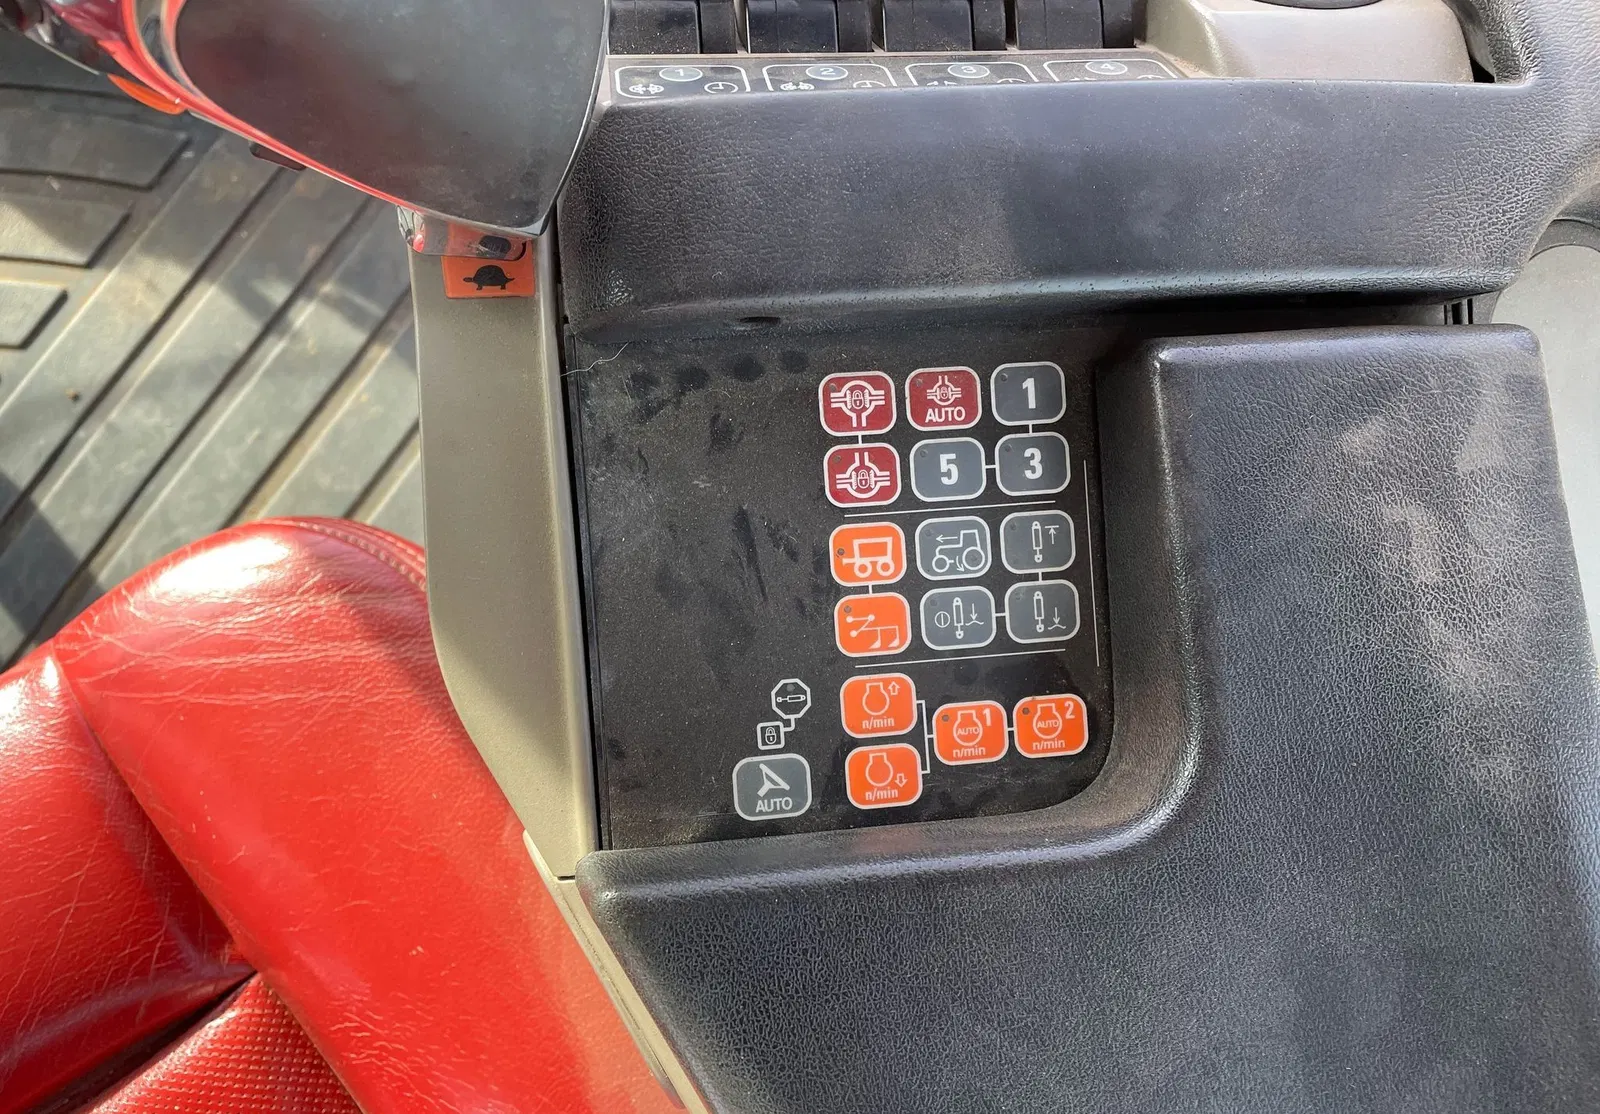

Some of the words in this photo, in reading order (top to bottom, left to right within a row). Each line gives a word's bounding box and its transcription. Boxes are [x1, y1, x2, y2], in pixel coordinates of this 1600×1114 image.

[677, 68, 686, 76] 1
[821, 67, 837, 75] 2
[962, 66, 976, 74] 3
[1100, 62, 1115, 71] 4
[1022, 378, 1036, 409] 1
[925, 406, 966, 423] AUTO
[939, 453, 959, 485] 5
[1023, 447, 1043, 480] 3
[983, 709, 991, 726] 1
[1065, 702, 1075, 719] 2
[862, 715, 895, 729] n/min
[1037, 719, 1059, 730] AUTO
[957, 725, 980, 737] AUTO
[953, 745, 986, 758] n/min
[1032, 738, 1066, 751] n/min
[865, 787, 899, 801] n/min
[755, 797, 793, 813] AUTO
